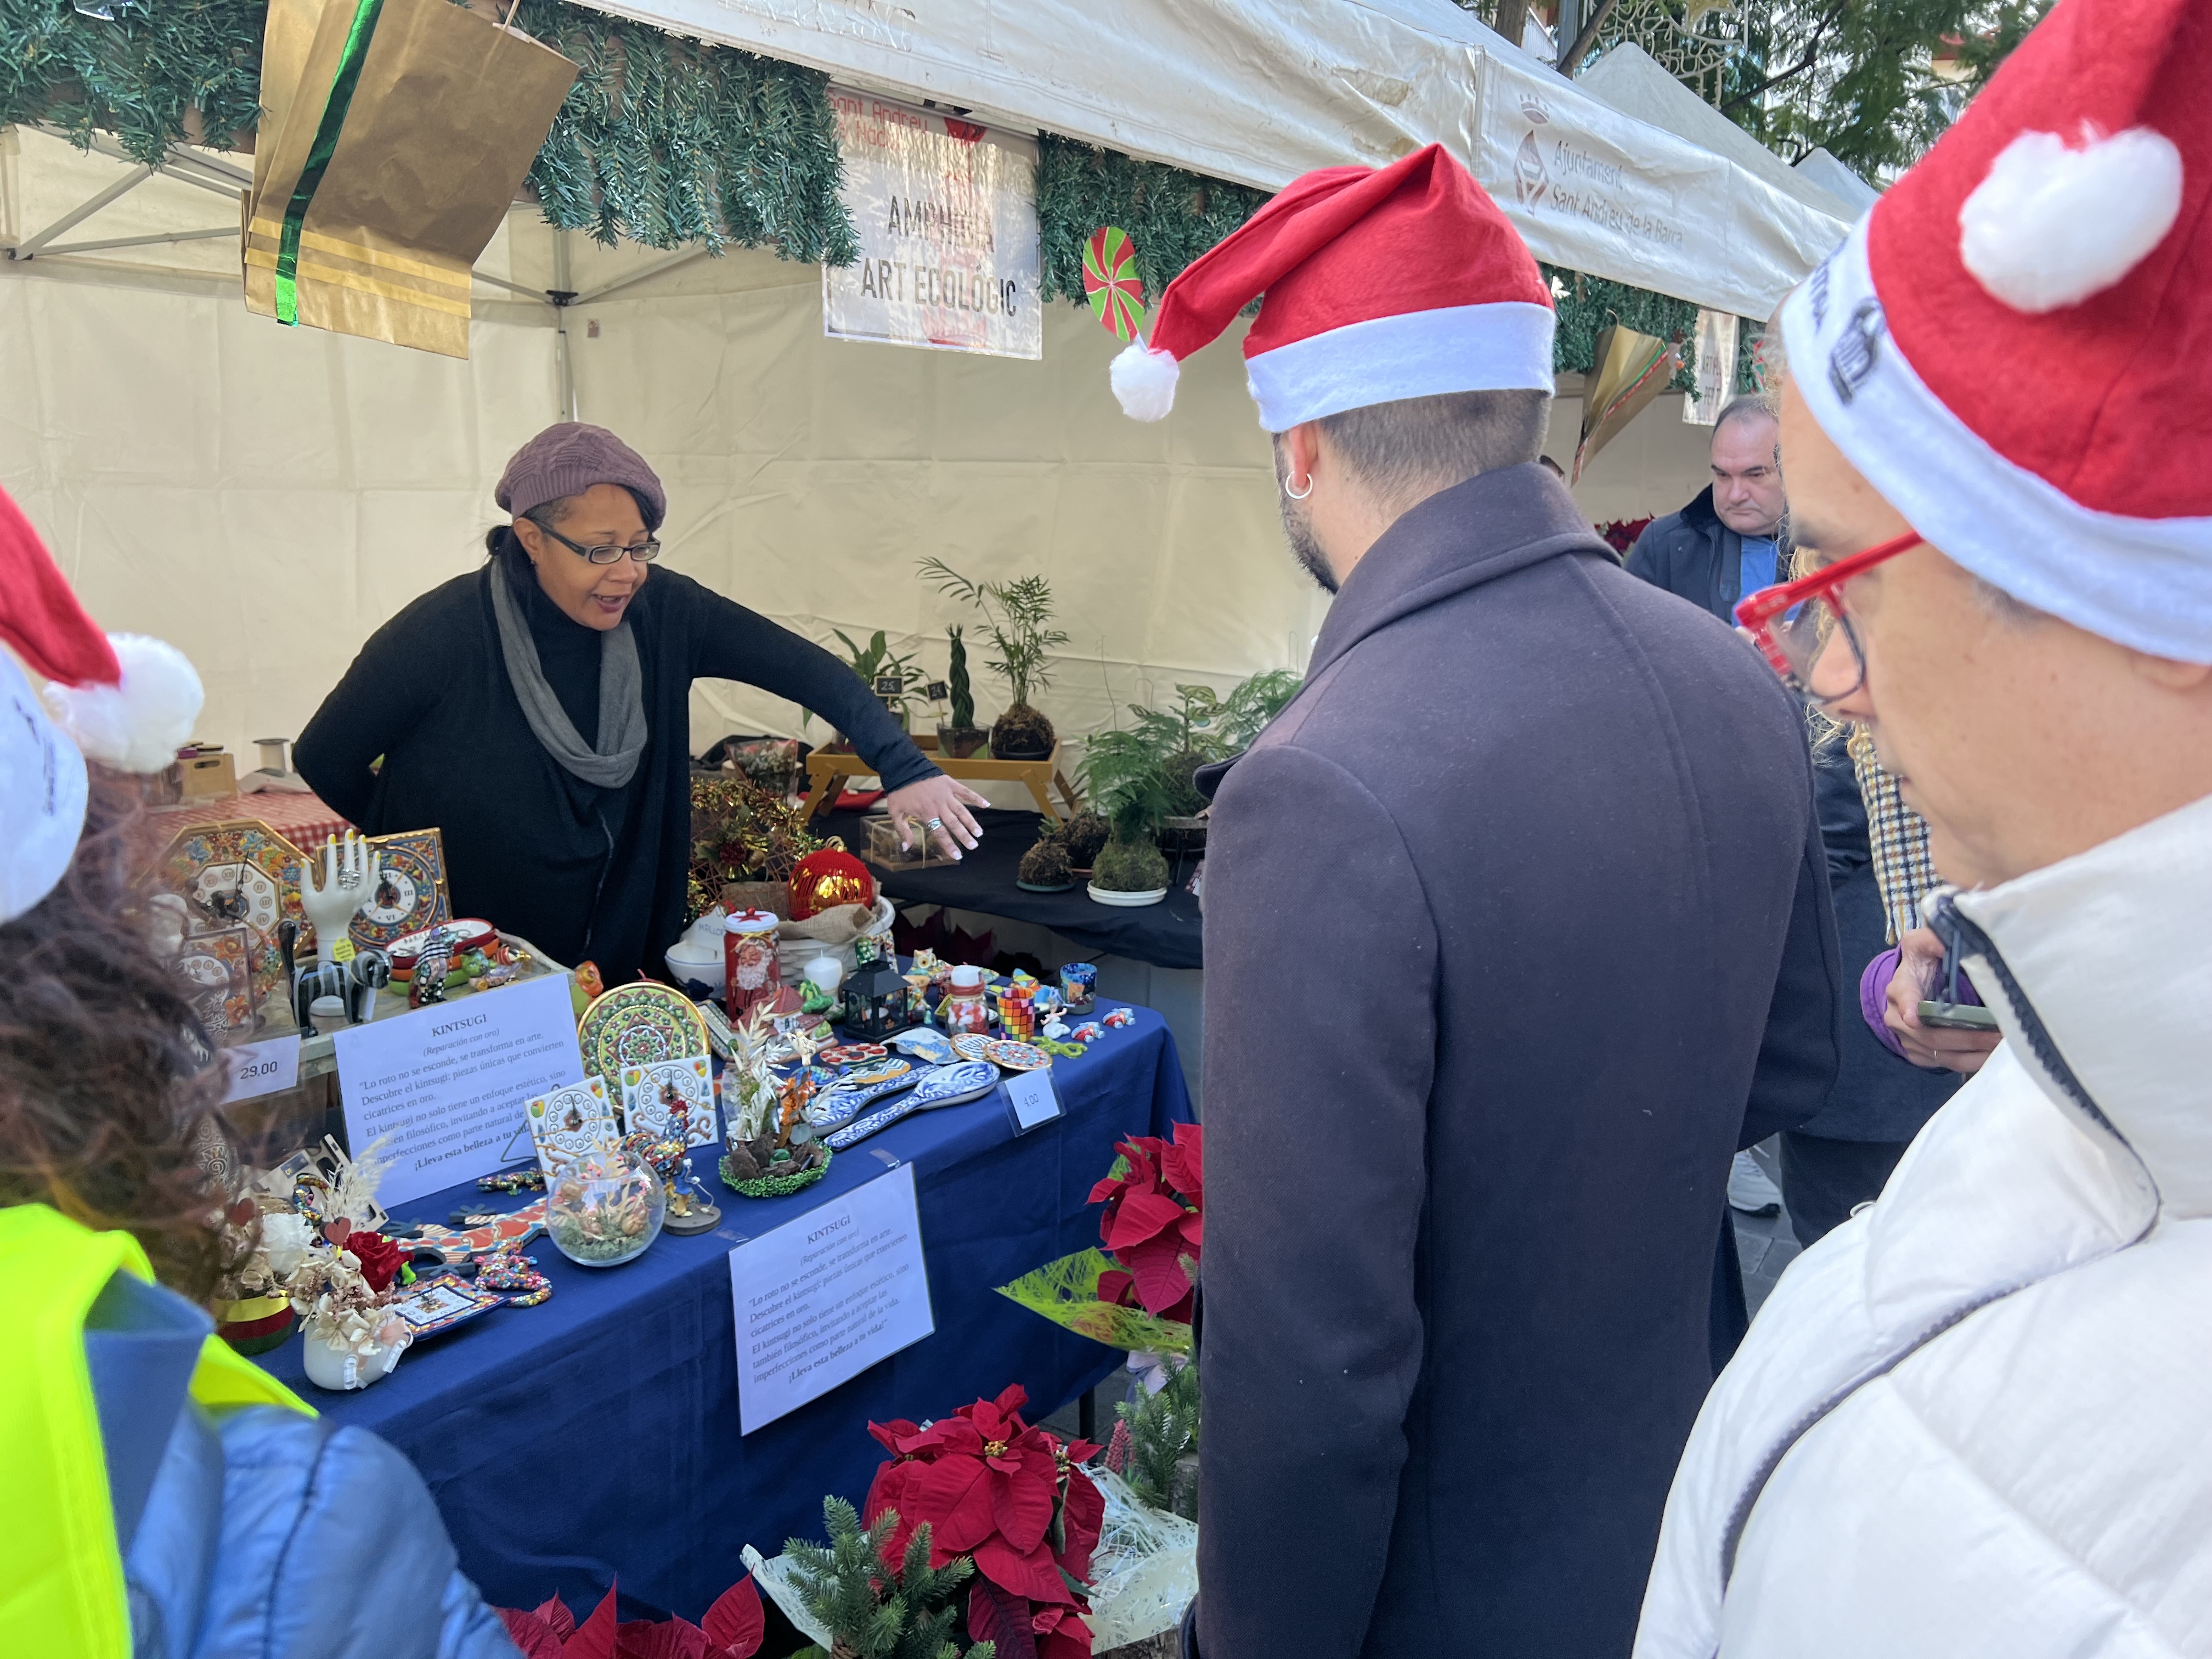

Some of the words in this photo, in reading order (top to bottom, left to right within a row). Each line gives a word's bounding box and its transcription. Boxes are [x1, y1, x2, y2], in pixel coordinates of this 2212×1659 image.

[1554, 140, 1623, 189] Ajuntament
[1550, 183, 1581, 216] Sant
[1582, 194, 1623, 231] Andreu
[860, 257, 906, 301] ART
[432, 1014, 486, 1036] KINTSUGI
[469, 1034, 482, 1042] con
[484, 1028, 499, 1039] oro)
[240, 1061, 277, 1080] 29,00
[359, 1081, 376, 1090] "Lo
[378, 1075, 396, 1086] roto
[398, 1071, 409, 1080] no
[411, 1068, 420, 1076] se
[422, 1056, 458, 1072] esconde,
[459, 1053, 468, 1062] se
[470, 1041, 513, 1058] transforma
[527, 1033, 543, 1042] arte.
[361, 1088, 402, 1105] Descubre
[404, 1082, 413, 1093] el
[414, 1073, 450, 1090] kintsugi:
[452, 1065, 478, 1081] piezas
[479, 1057, 505, 1070] únicas
[507, 1053, 521, 1064] que
[523, 1040, 563, 1057] convierten
[364, 1102, 405, 1120] cicatrices
[407, 1099, 417, 1107] en
[419, 1094, 436, 1103] oro.
[366, 1126, 376, 1137] El
[415, 1113, 426, 1122] no
[428, 1106, 445, 1118] solo
[447, 1100, 467, 1111] tiene
[469, 1096, 479, 1104] un
[482, 1086, 514, 1101] enfoque
[549, 1070, 566, 1080] sino
[450, 1107, 488, 1125] invitando
[375, 1143, 437, 1165] mperfecciones
[438, 1132, 461, 1144] como
[462, 1124, 482, 1138] parte
[484, 1113, 512, 1129] natural
[514, 1110, 523, 1119] de
[414, 1155, 442, 1171] ¡Lleva
[444, 1148, 461, 1159] esta
[463, 1138, 493, 1152] belleza
